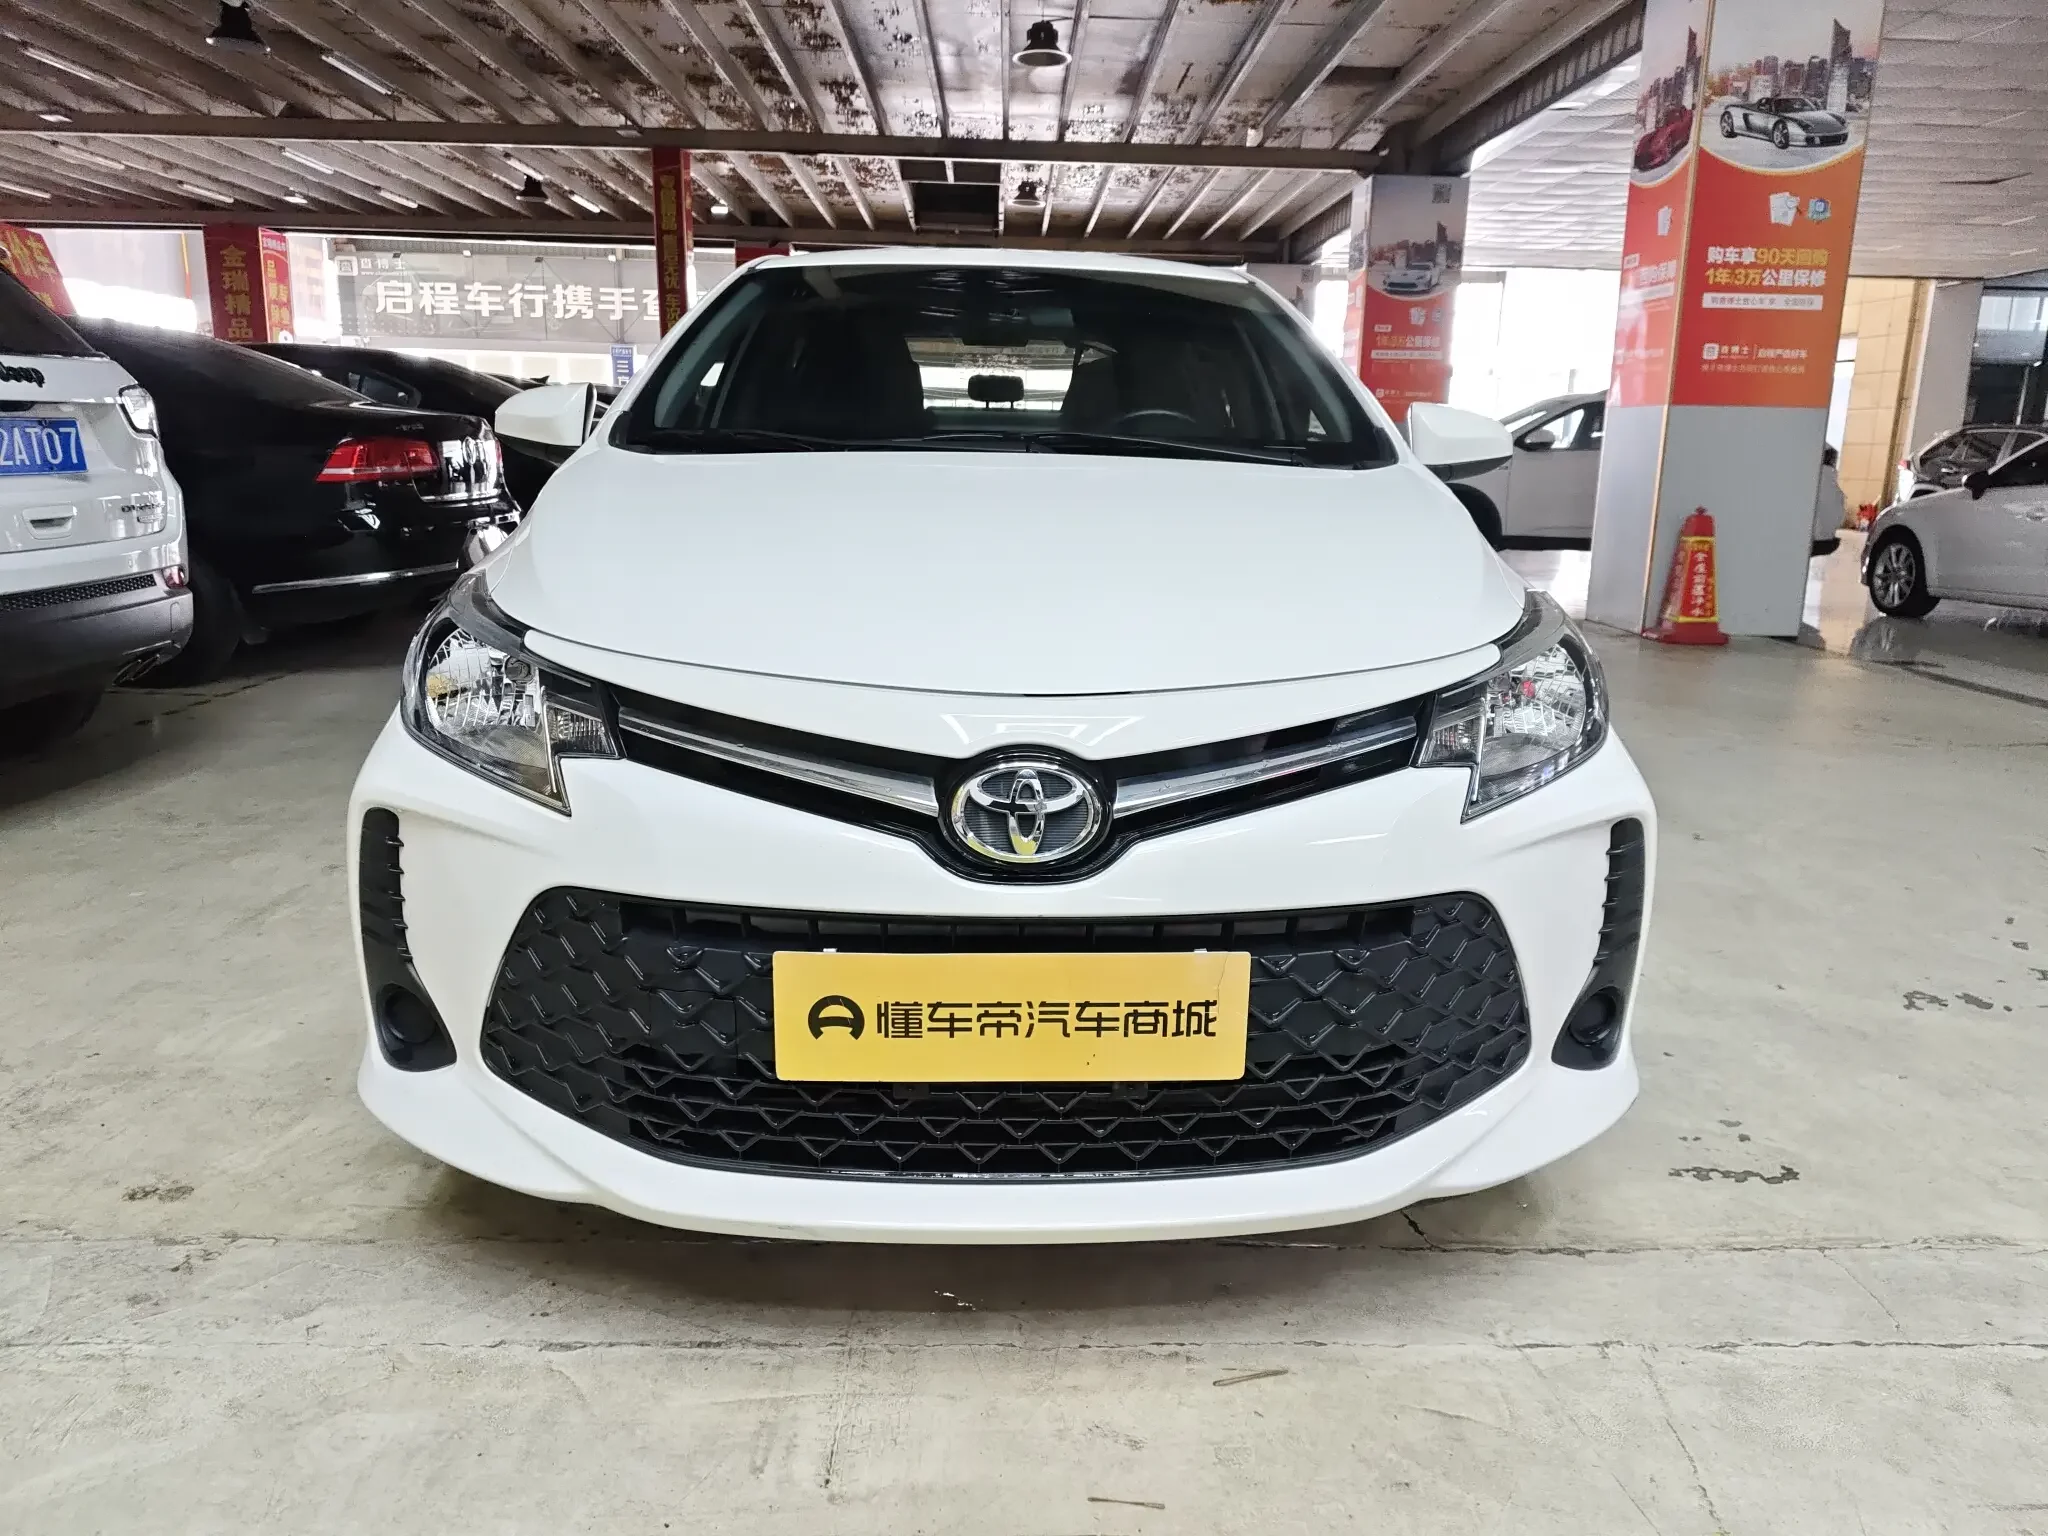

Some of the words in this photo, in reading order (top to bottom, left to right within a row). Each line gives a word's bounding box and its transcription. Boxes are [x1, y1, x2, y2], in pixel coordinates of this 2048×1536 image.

[0, 361, 46, 388] eep
[875, 1000, 1218, 1039] 懂车帝汽车商城
